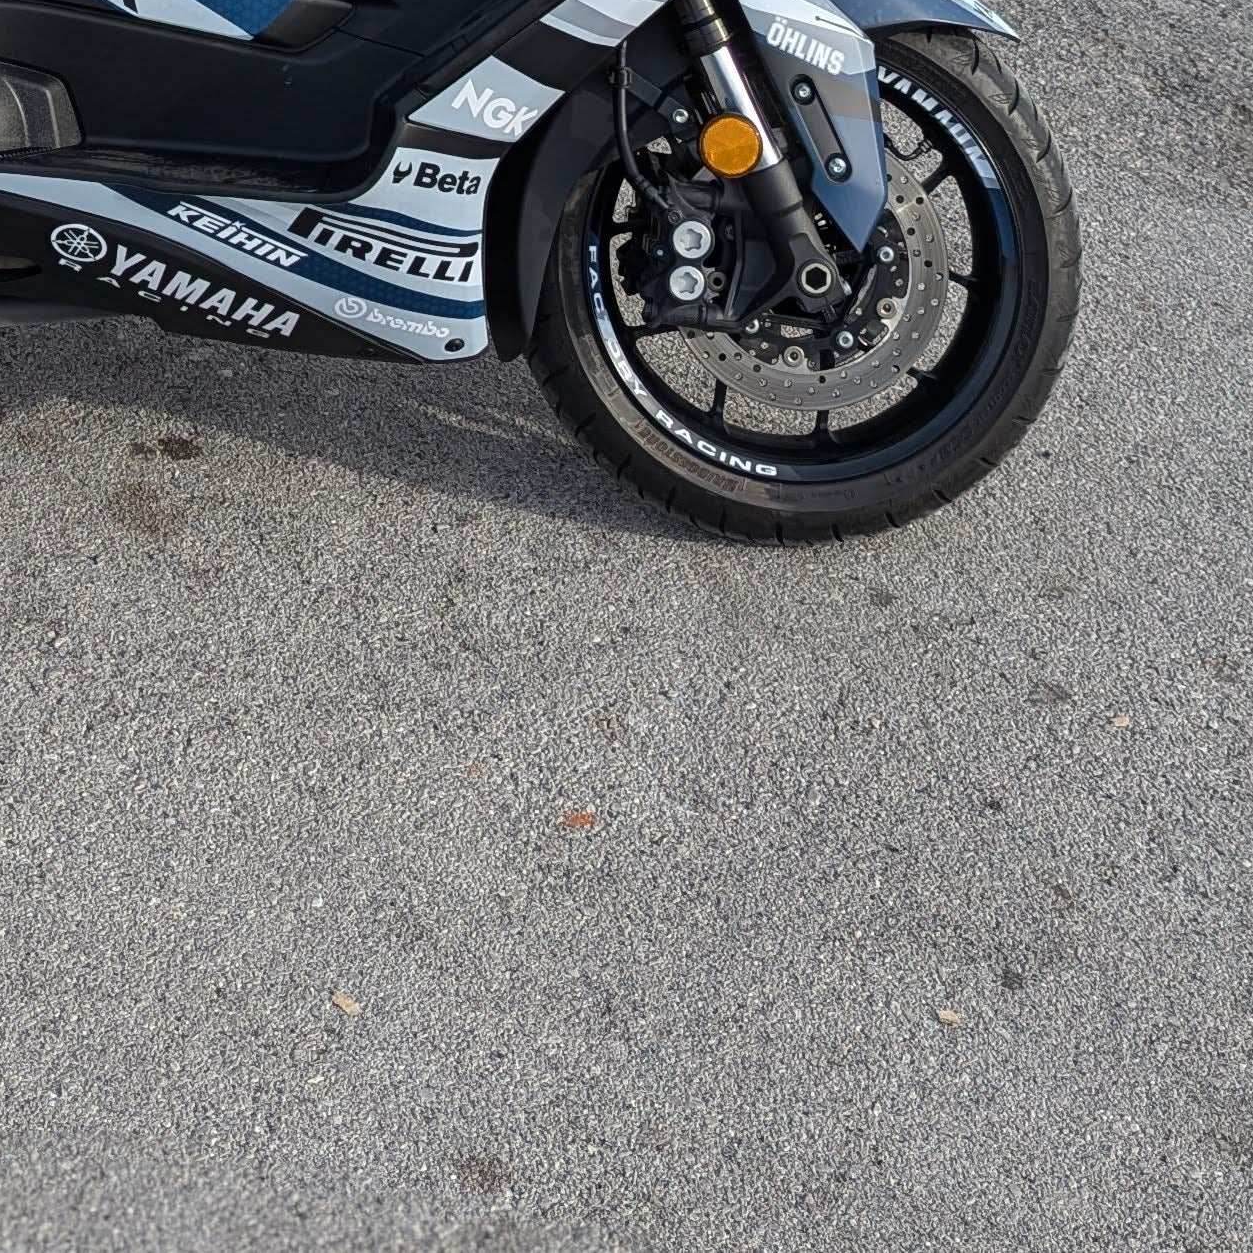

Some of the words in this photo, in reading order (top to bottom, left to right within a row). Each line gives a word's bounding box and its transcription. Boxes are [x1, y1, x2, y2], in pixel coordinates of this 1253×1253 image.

[767, 16, 845, 75] ÖHLINS
[451, 78, 539, 137] NGK
[413, 162, 482, 195] Beta
[167, 201, 309, 267] KEIHIN
[287, 207, 480, 283] PIRELLI
[109, 244, 301, 337] YAMAHA
[366, 307, 450, 338] brembo
[588, 245, 648, 397] FACORY
[655, 409, 778, 477] RACING
